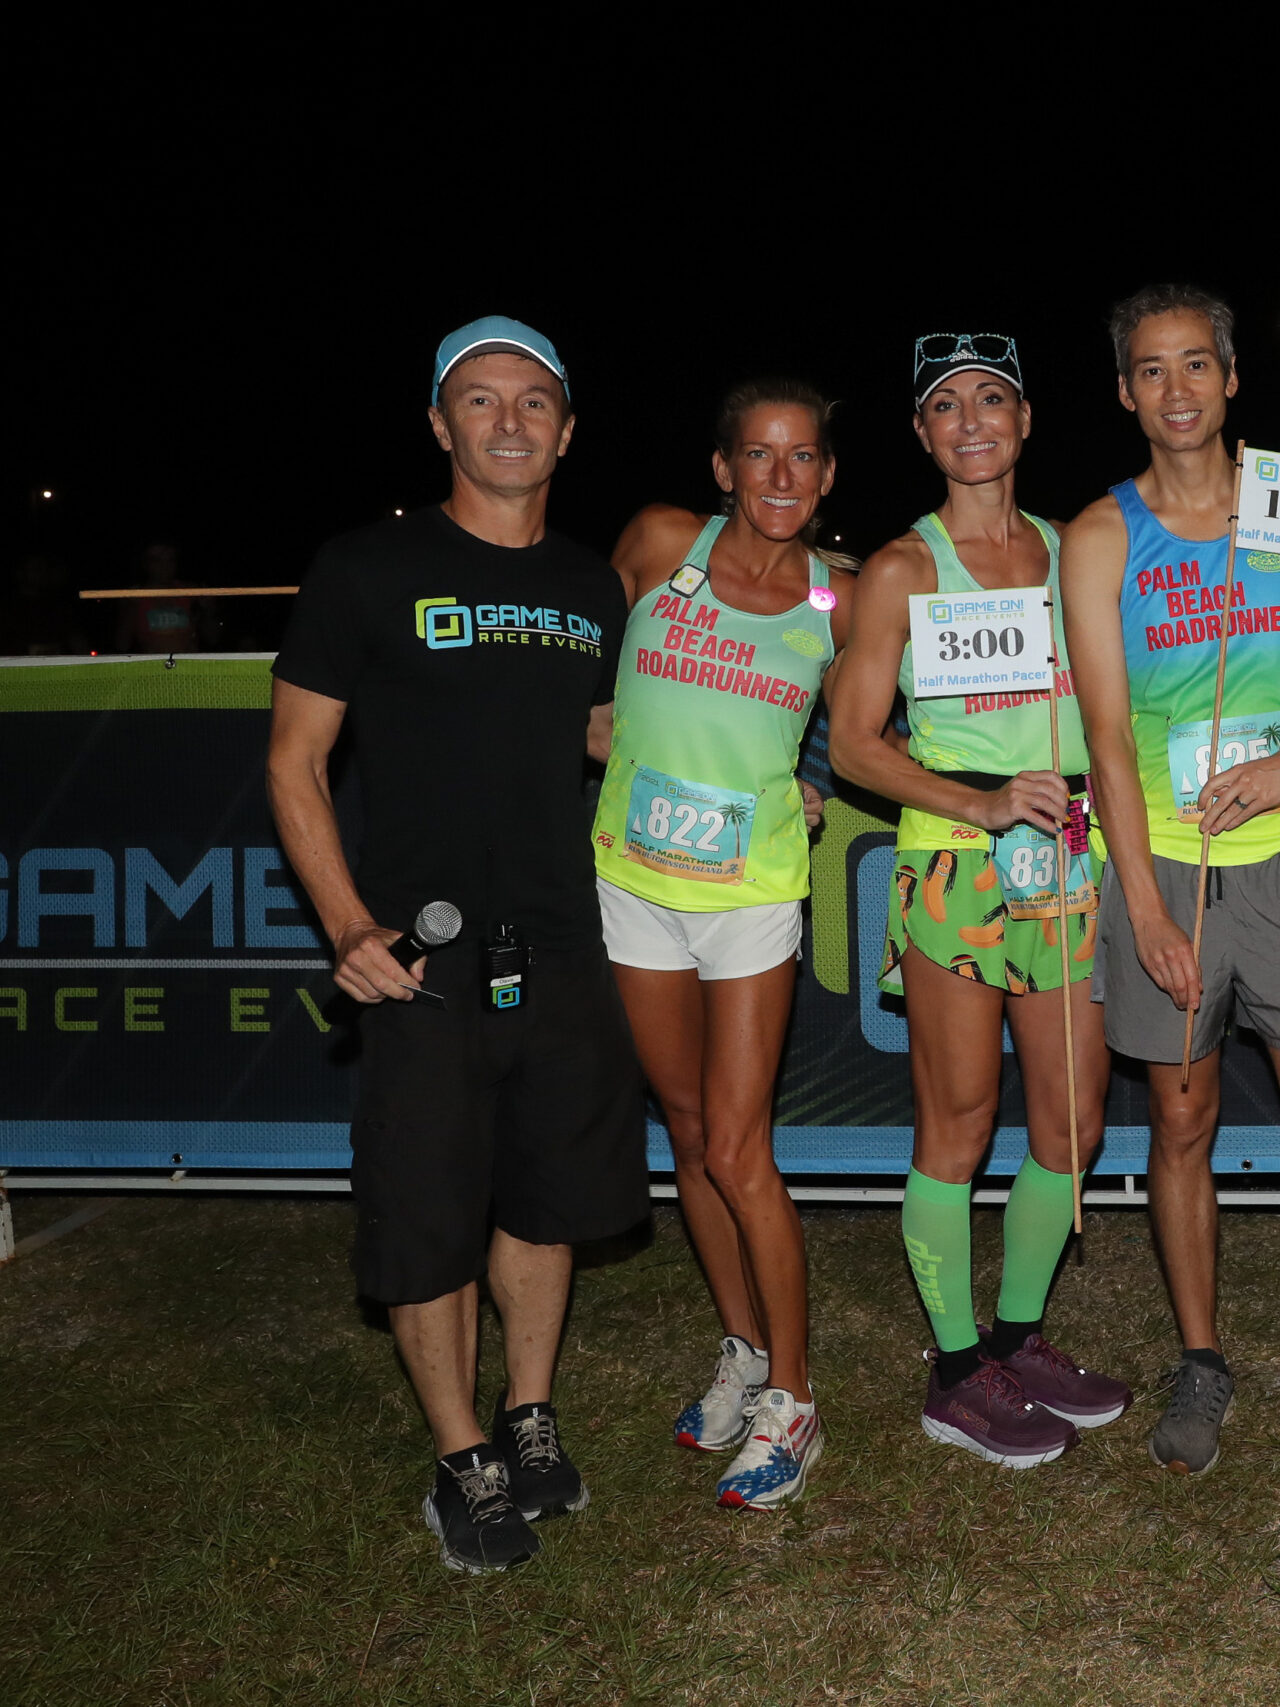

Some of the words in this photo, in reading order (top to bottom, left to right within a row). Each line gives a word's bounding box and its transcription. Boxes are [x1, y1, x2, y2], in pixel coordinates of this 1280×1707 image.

[1236, 527, 1260, 540] Half
[1137, 560, 1202, 596] PALM
[650, 594, 720, 631] PALM
[954, 601, 996, 614] GAME
[1000, 599, 1024, 611] ON!
[986, 612, 1025, 620] EVENTS
[1166, 581, 1246, 618] BEACH
[476, 605, 562, 630] GAME
[567, 614, 602, 642] ON!
[479, 633, 530, 643] RACE
[541, 635, 602, 657] EVENTS
[663, 624, 756, 667] BEACH
[938, 626, 1024, 662] 3:00
[636, 648, 810, 713] ROADRUNNERS
[918, 674, 945, 687] Half
[947, 672, 1008, 686] Marathon
[1012, 670, 1047, 682] Pacer
[647, 796, 725, 853] 822
[630, 838, 655, 852] HALF
[657, 849, 722, 867] MARATHON
[642, 850, 691, 870] HUTCHINSON
[691, 864, 723, 874] ISLAND
[0, 847, 321, 948] AME
